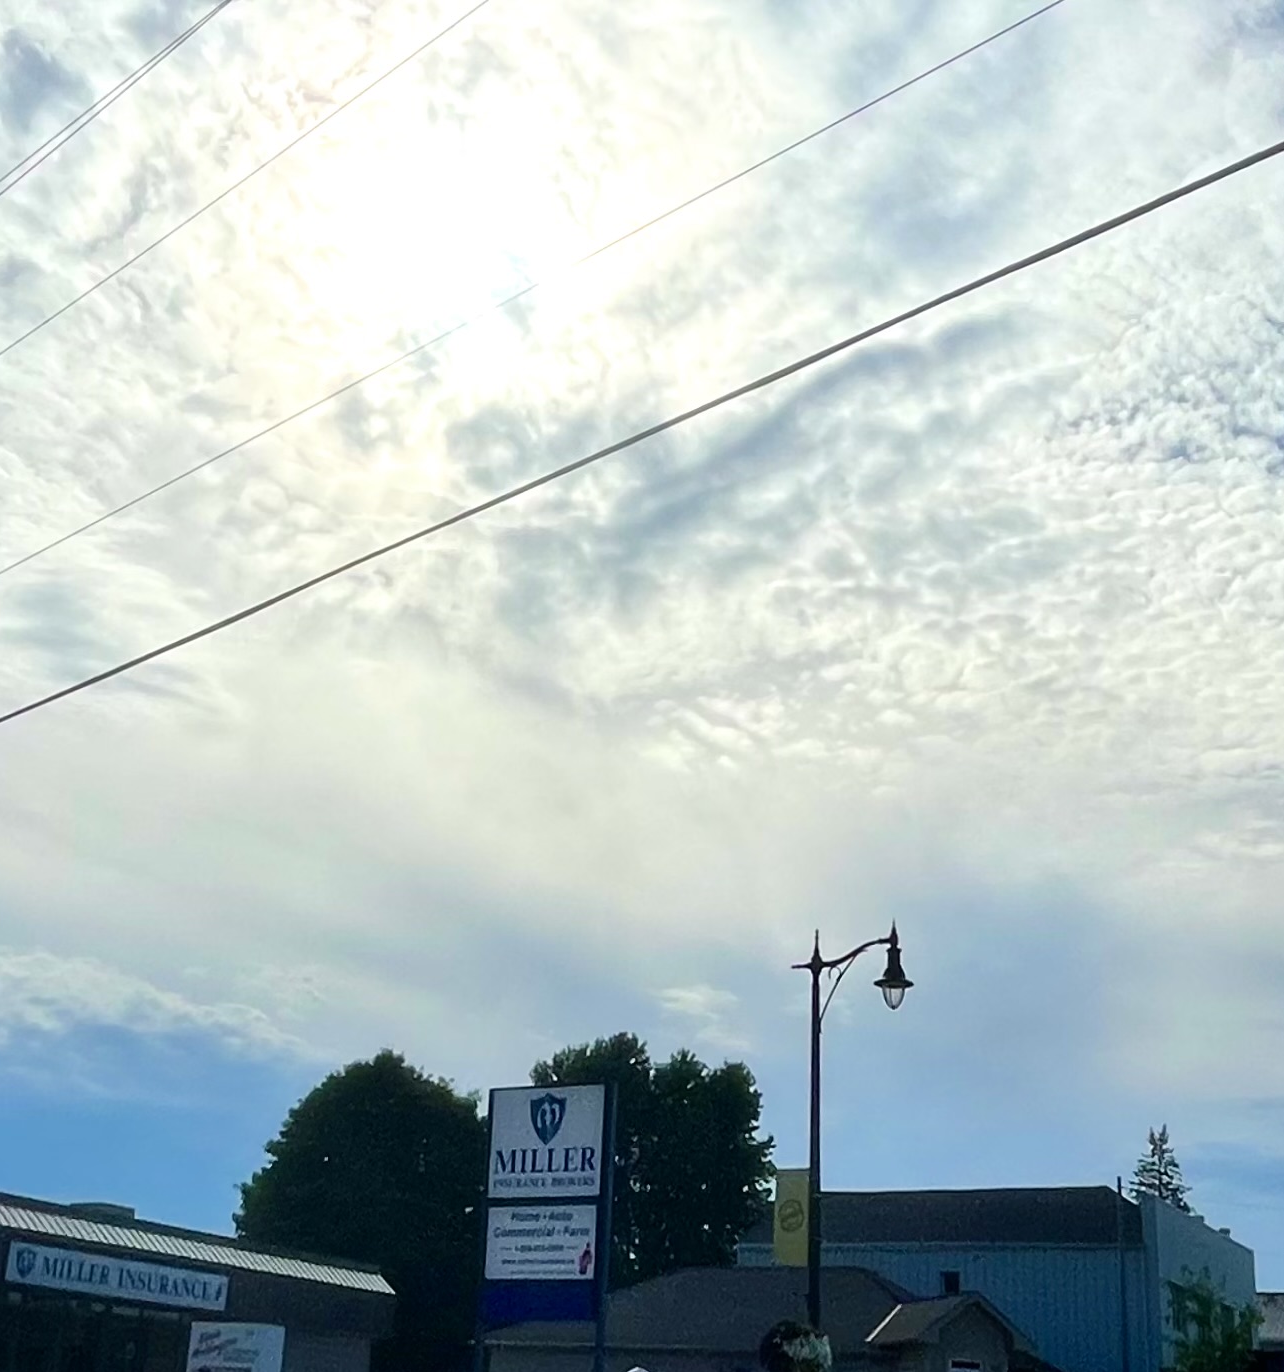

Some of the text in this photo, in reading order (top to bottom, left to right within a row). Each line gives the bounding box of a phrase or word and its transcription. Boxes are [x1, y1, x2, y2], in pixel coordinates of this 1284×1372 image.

[494, 1147, 596, 1175] MILLER
[41, 1255, 214, 1302] MILLER INSURANCE
